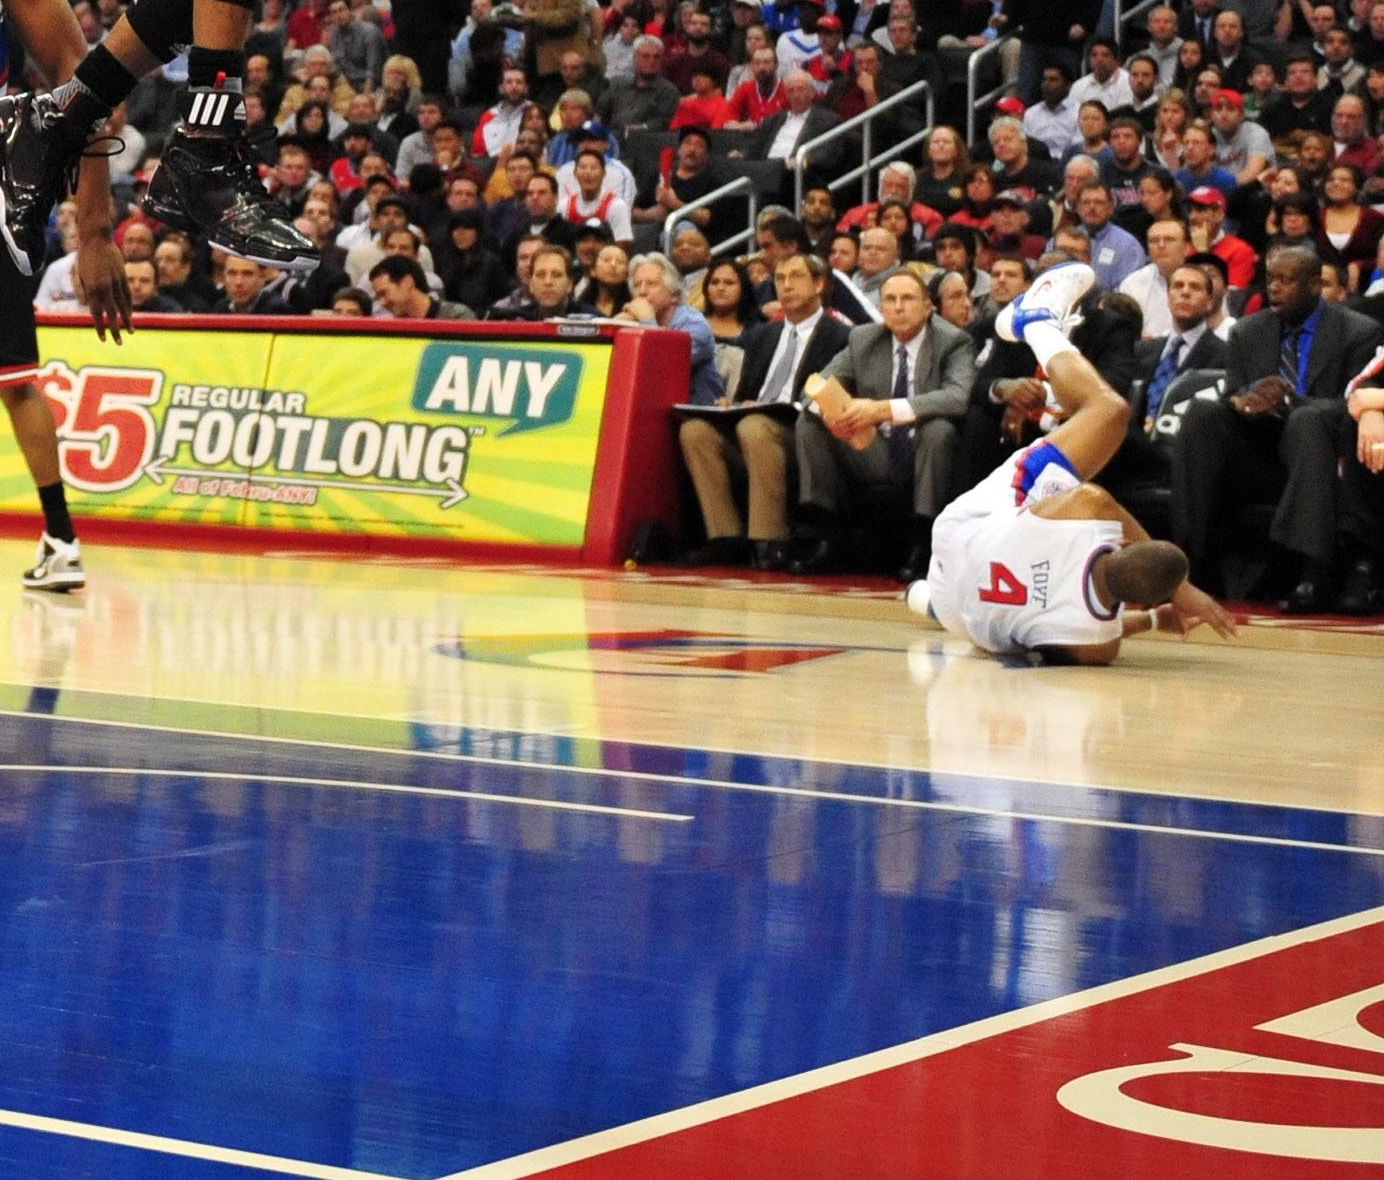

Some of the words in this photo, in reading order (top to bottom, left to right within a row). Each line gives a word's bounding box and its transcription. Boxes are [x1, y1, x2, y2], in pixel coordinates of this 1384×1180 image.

[172, 385, 306, 415] REGULAR
[425, 355, 567, 418] ANY
[38, 361, 162, 491] $5
[978, 562, 1028, 606] 4
